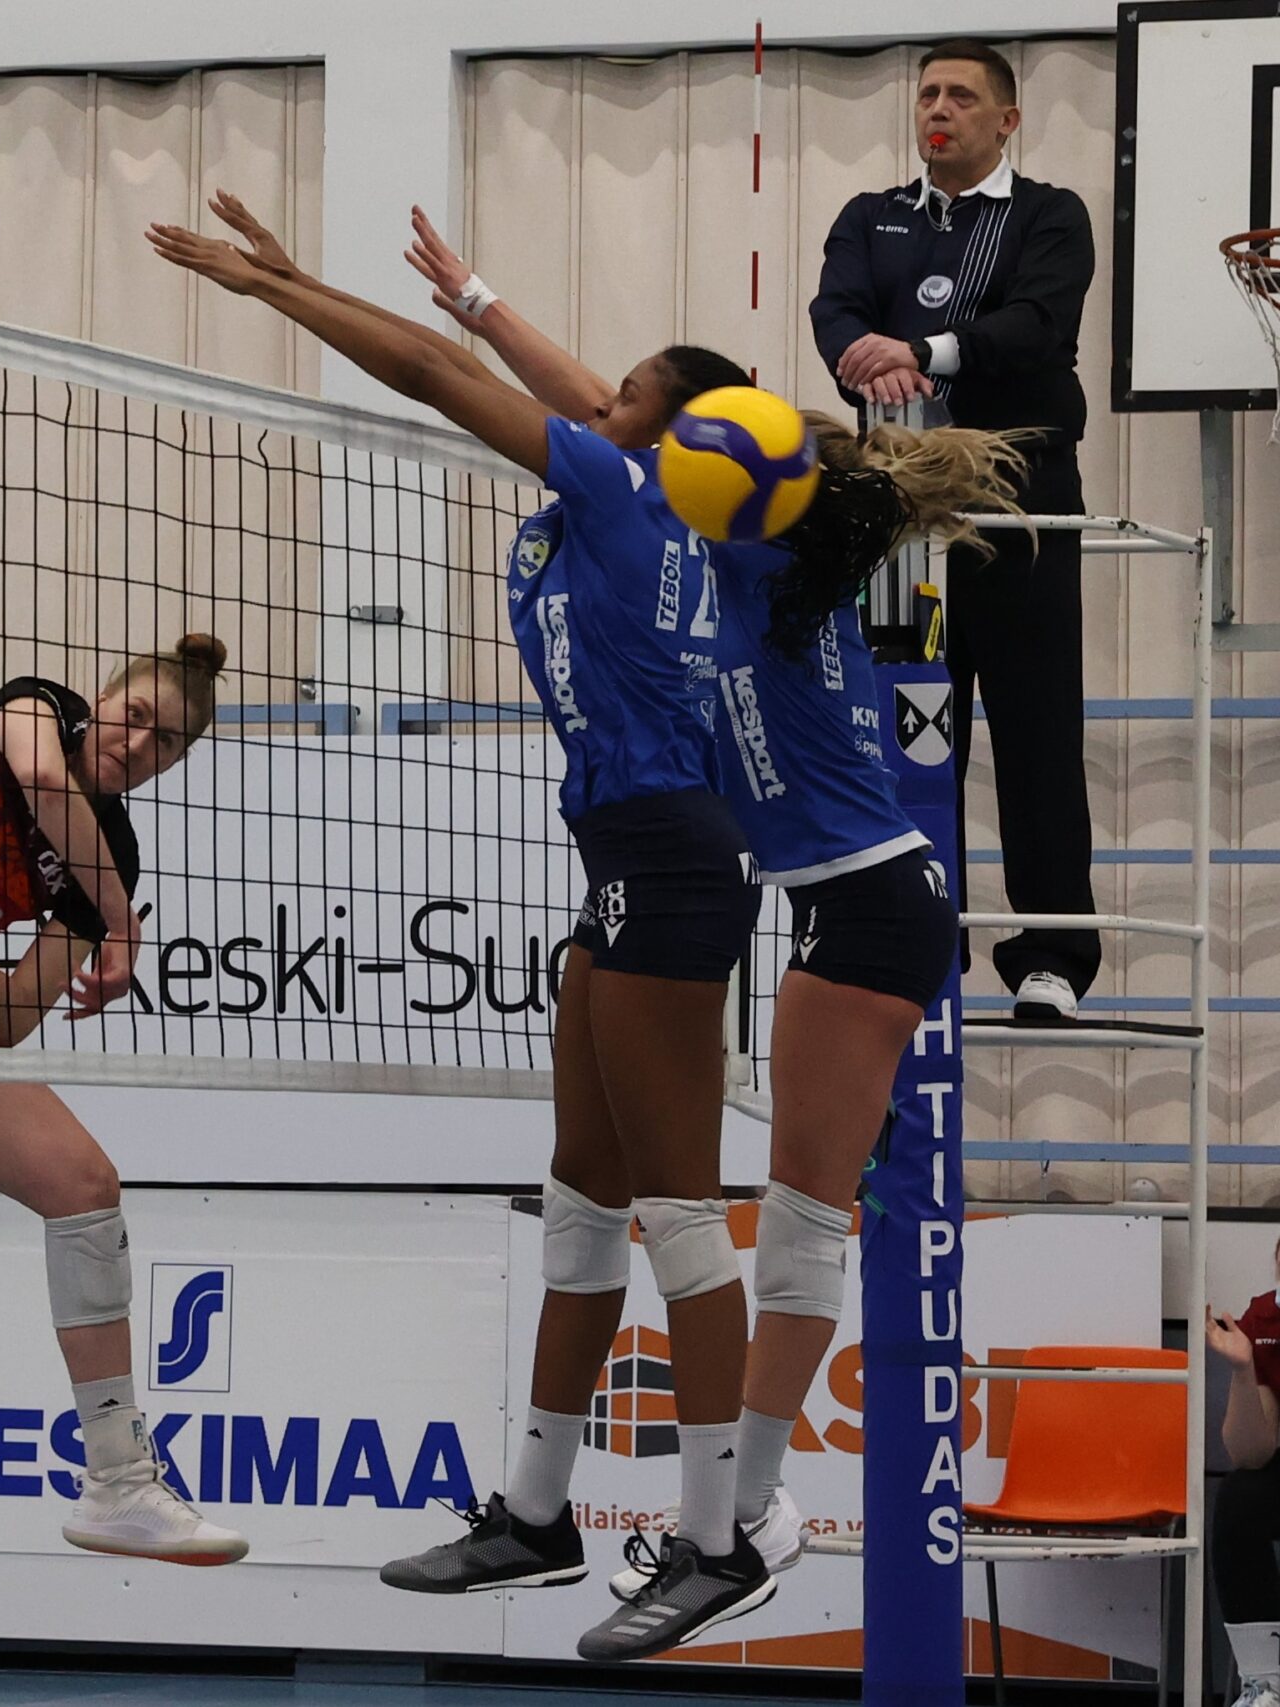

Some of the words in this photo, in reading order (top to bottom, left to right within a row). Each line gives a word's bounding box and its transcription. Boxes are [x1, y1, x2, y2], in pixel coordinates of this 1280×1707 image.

[658, 546, 679, 625] TEBOIL
[547, 592, 589, 734] kesport
[731, 664, 787, 800] kesport
[913, 861, 962, 1566] HTIPUDAS
